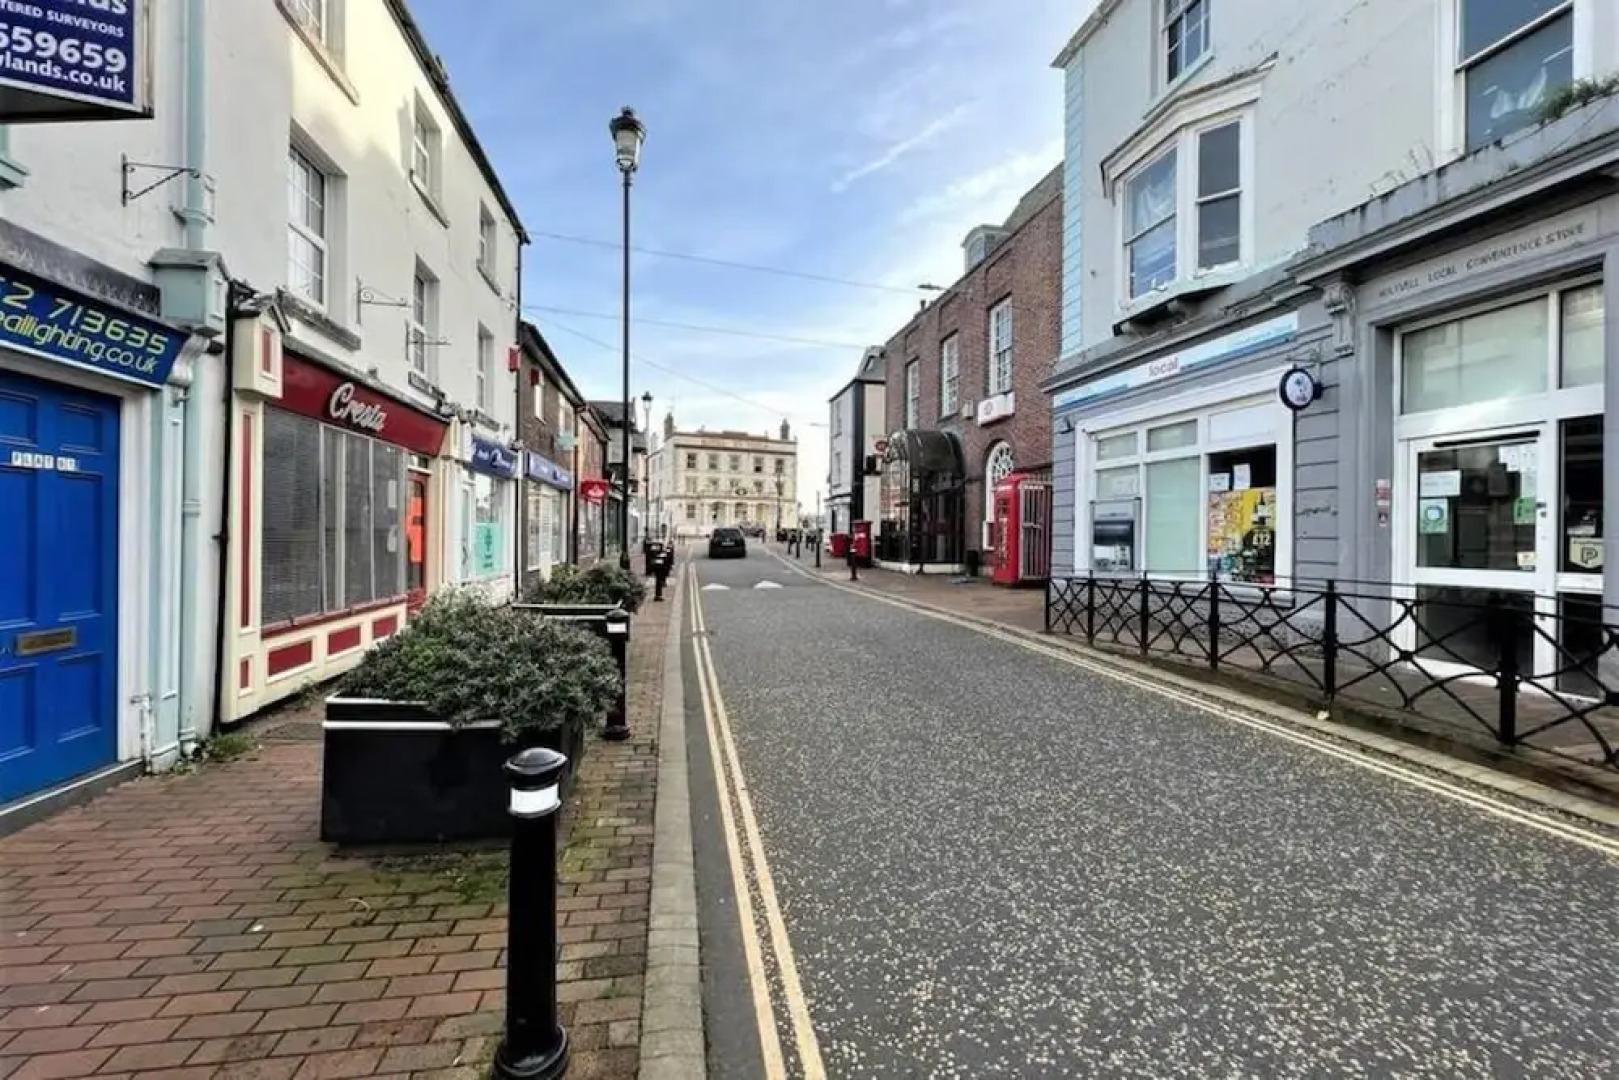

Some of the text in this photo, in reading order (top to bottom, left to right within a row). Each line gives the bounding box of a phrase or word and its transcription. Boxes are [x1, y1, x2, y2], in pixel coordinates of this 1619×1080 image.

[46, 9, 125, 38] SURVEYORS
[0, 276, 169, 356] 2 713635
[1148, 356, 1179, 377] local
